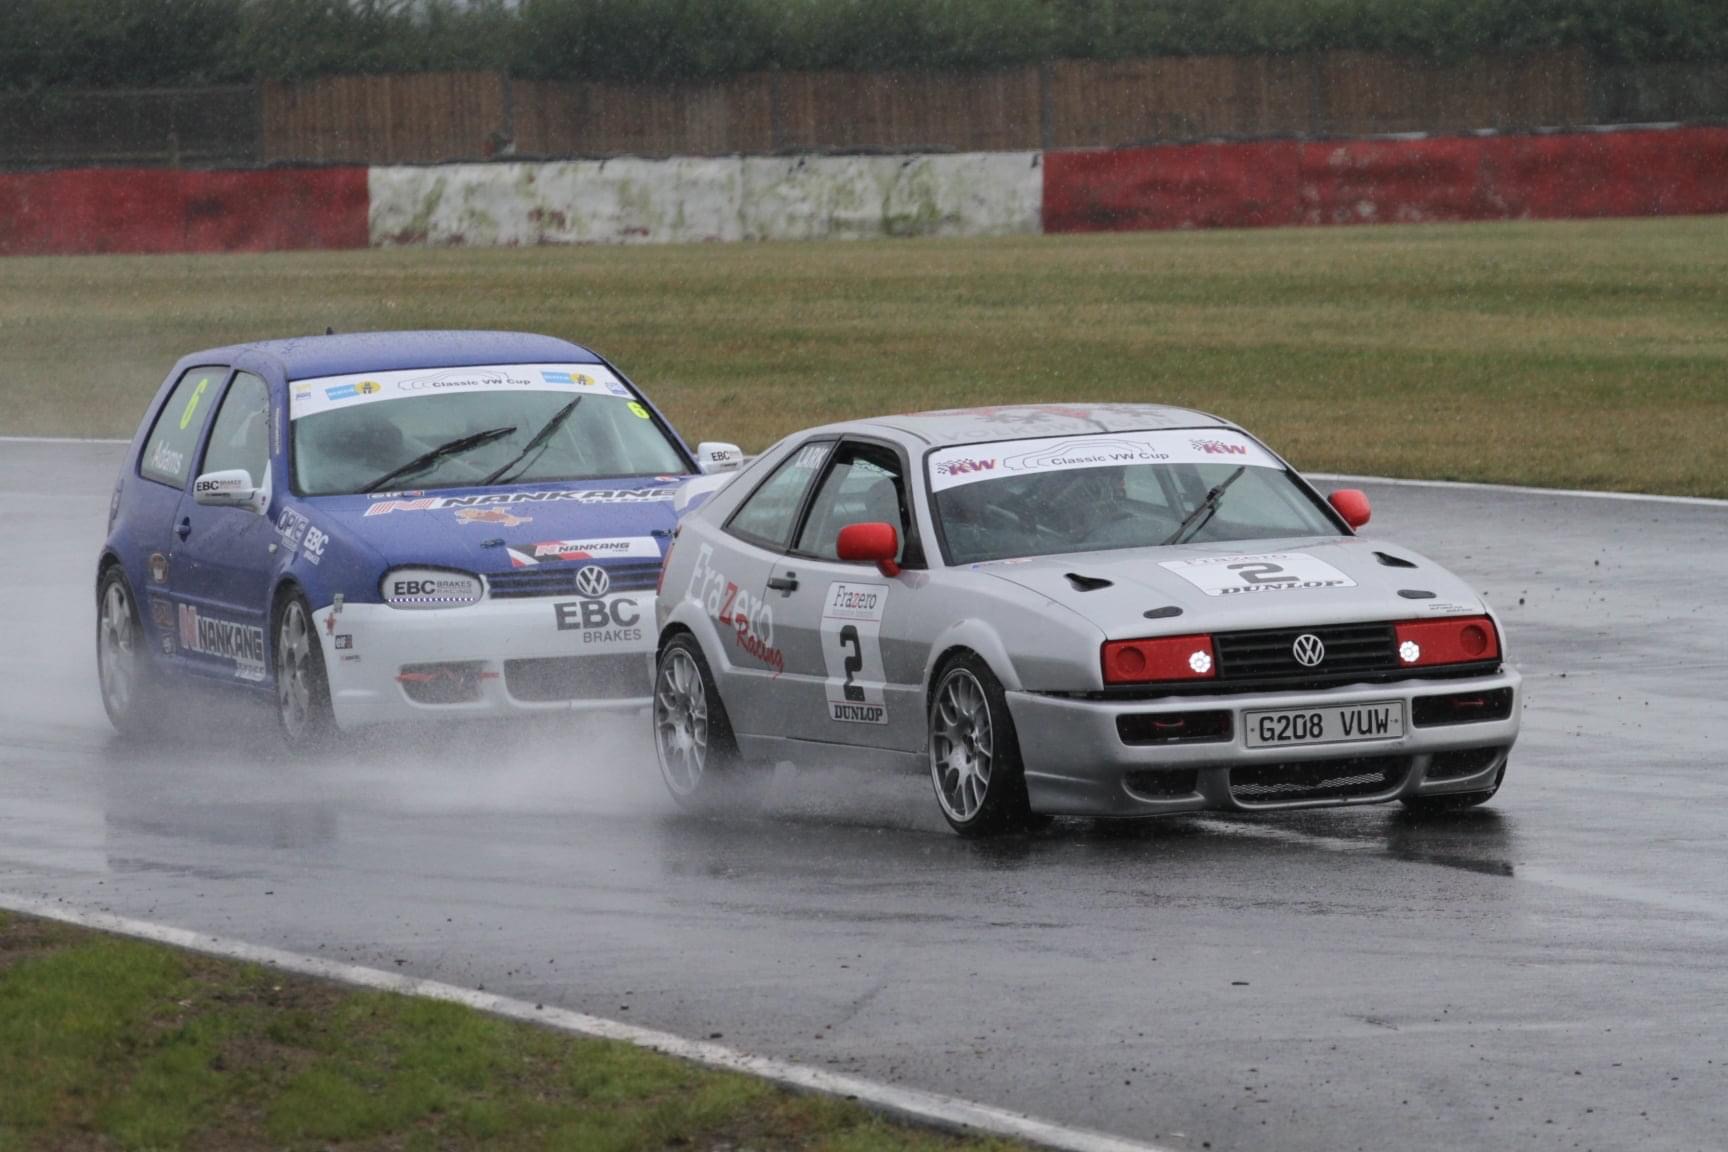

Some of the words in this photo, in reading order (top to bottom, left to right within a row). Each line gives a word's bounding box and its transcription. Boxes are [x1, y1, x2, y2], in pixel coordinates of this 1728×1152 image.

[432, 379, 478, 388] Classic
[506, 378, 531, 386] Cup
[178, 378, 208, 430] 6
[626, 401, 650, 419] 6
[710, 451, 730, 462] EBC
[1201, 440, 1247, 455] KW
[948, 458, 995, 476] KW
[1051, 454, 1106, 466] Classic
[1109, 452, 1135, 461] VW
[1140, 450, 1170, 462] Cup
[196, 480, 219, 492] EBC
[303, 526, 329, 556] EBC
[559, 542, 630, 552] NANKANG
[1226, 562, 1301, 584] 2
[394, 580, 436, 595] EBC
[436, 580, 473, 588] BRAKES
[684, 542, 774, 648] Frazero
[1220, 580, 1345, 595] DUNLOP
[833, 585, 878, 609] Frazero
[553, 598, 641, 631] EBC
[198, 617, 264, 662] NANKANG
[583, 629, 643, 643] BRAKES
[735, 613, 785, 680] Racing
[839, 624, 866, 702] 2
[834, 704, 884, 722] DUNLOP
[1259, 713, 1324, 742] G208
[1340, 708, 1390, 736] VUW
